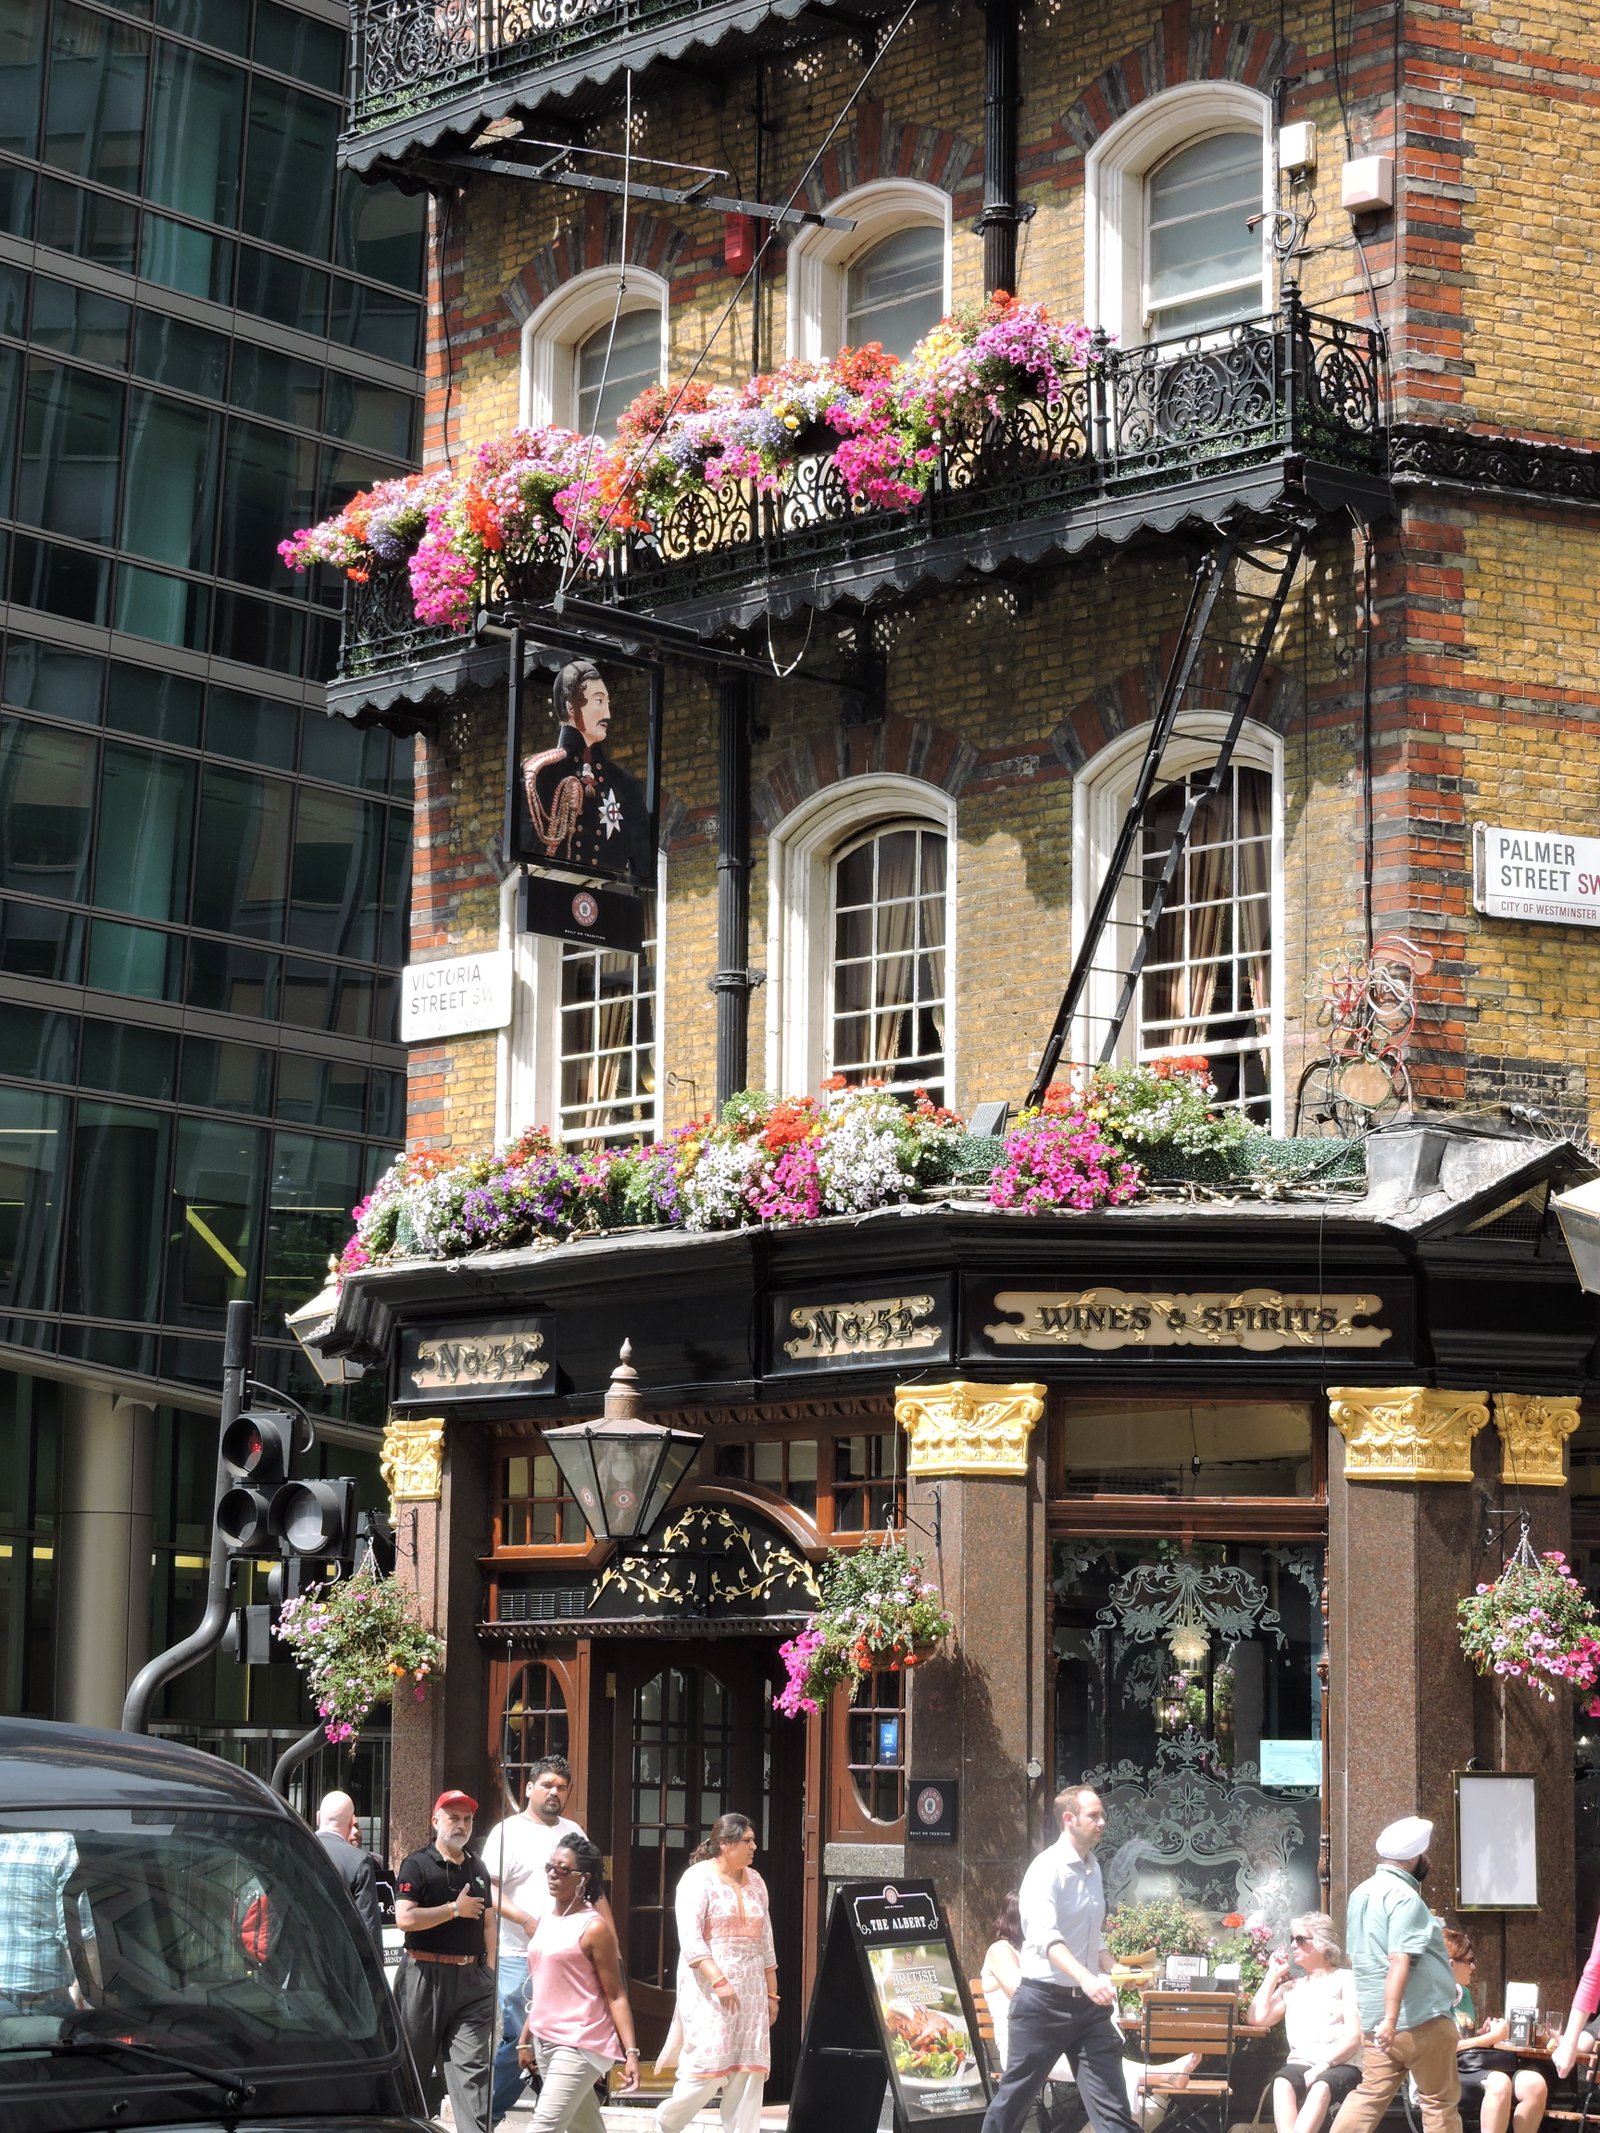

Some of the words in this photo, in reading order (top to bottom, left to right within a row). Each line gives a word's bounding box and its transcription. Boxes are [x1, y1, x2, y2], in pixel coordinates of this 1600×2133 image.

[1500, 838, 1575, 866] PALMER
[1501, 865, 1570, 892] STREET
[1501, 901, 1520, 912] CITY
[1523, 903, 1534, 913] OF
[1536, 904, 1597, 919] WESTMINSTER
[412, 963, 481, 992] VICTORIA
[411, 989, 468, 1015] STREET
[1037, 1306, 1151, 1330] WINES
[1167, 1308, 1186, 1329] &
[1200, 1307, 1338, 1332] SPIRITS
[869, 1919, 889, 1931] THE
[892, 1916, 927, 1930] ALBERT
[891, 1969, 938, 1986] BRITISH
[894, 1985, 922, 1994] SUMMER
[924, 1983, 940, 1991] TIME
[896, 1992, 943, 2001] FAVOURITES
[1513, 2025, 1525, 2038] 41
